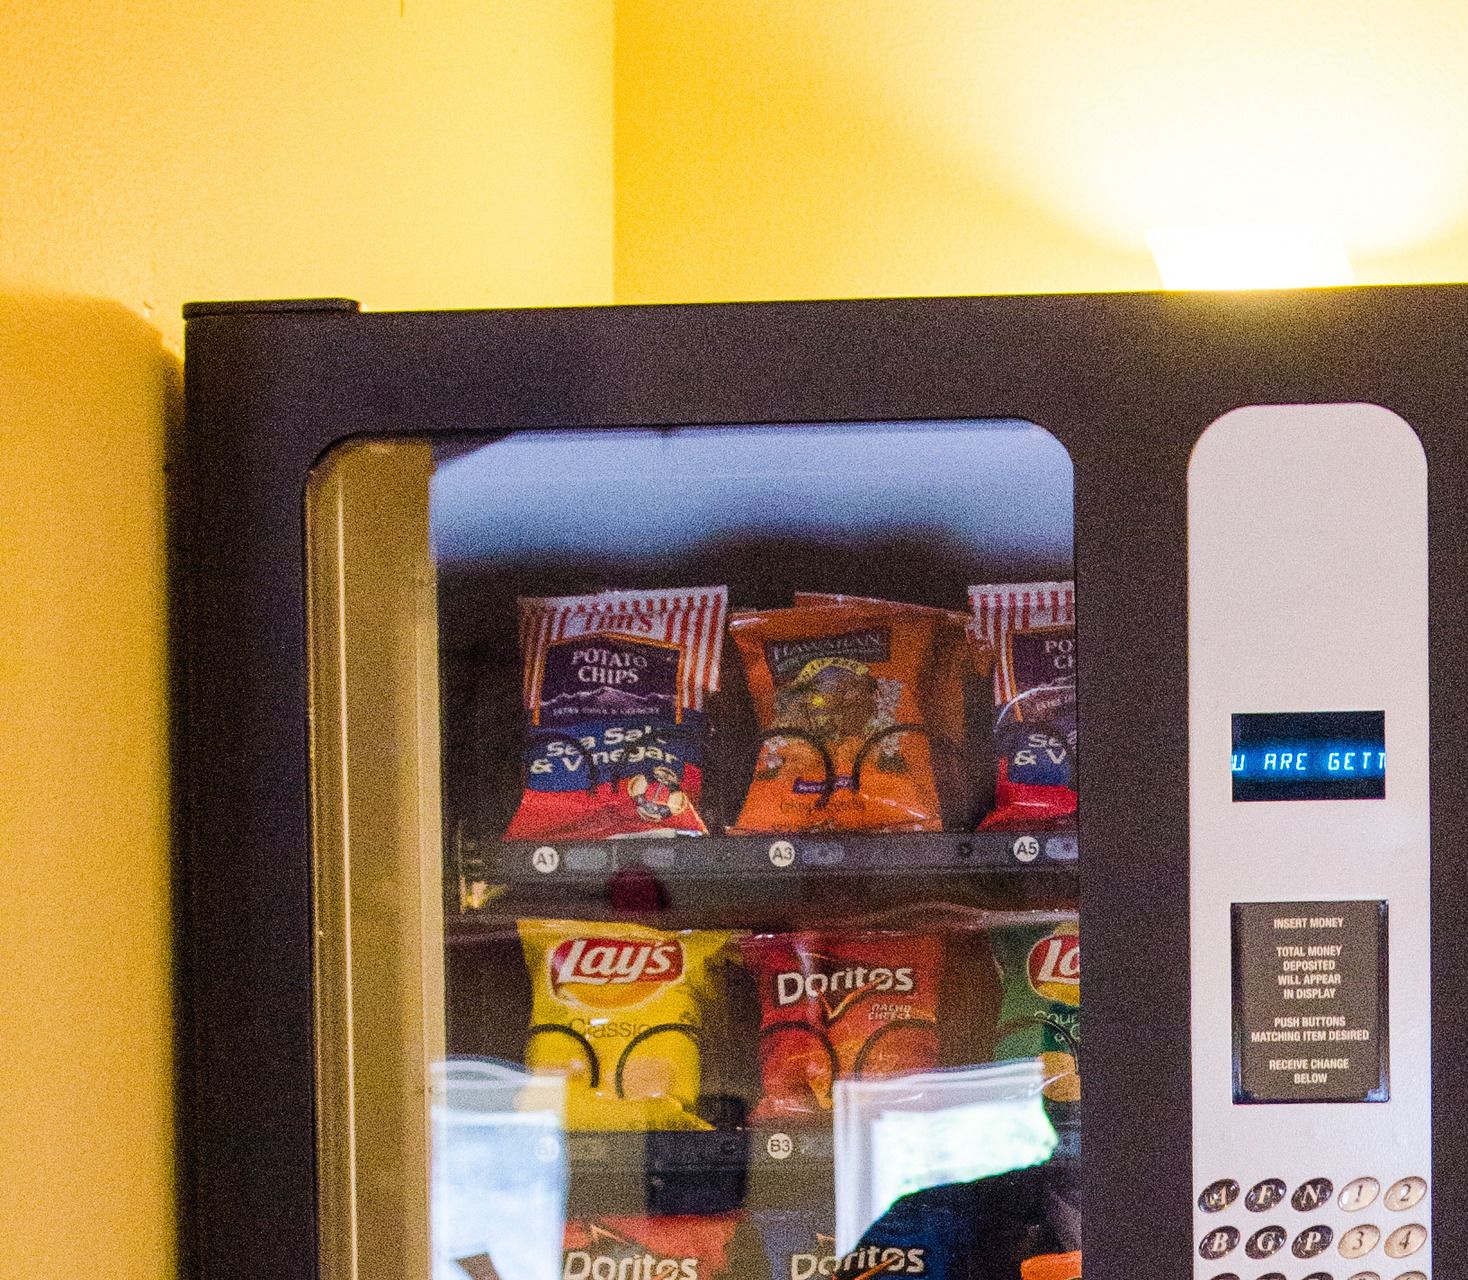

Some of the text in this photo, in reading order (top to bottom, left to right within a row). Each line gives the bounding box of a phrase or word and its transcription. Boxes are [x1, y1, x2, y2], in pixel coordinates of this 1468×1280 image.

[570, 648, 648, 669] POTATO
[577, 666, 640, 685] CHIPS
[562, 746, 680, 773] Vnegar
[1264, 752, 1308, 771] ARE
[772, 846, 792, 860] A3
[1016, 842, 1037, 856] A5
[536, 852, 556, 866] A1
[1273, 917, 1344, 929] INSERT MONEY
[1276, 945, 1342, 957] TOTAL MONEY
[1283, 960, 1335, 971] DEPOSITED
[1278, 974, 1341, 985] WILL APPEAR
[776, 967, 914, 1006] Doritos
[1284, 988, 1336, 999] IN DISPLAY
[1274, 1016, 1345, 1028] PUSH BUTTONS
[1251, 1030, 1369, 1042] MATCHING ITEM DESIRED
[1269, 1058, 1349, 1070] RECEIVE CHANGE
[1294, 1073, 1327, 1084] BELOW
[771, 1140, 791, 1152] B3
[1217, 1184, 1411, 1204] A F N 1 2
[1214, 1232, 1411, 1251] B G P 3 4
